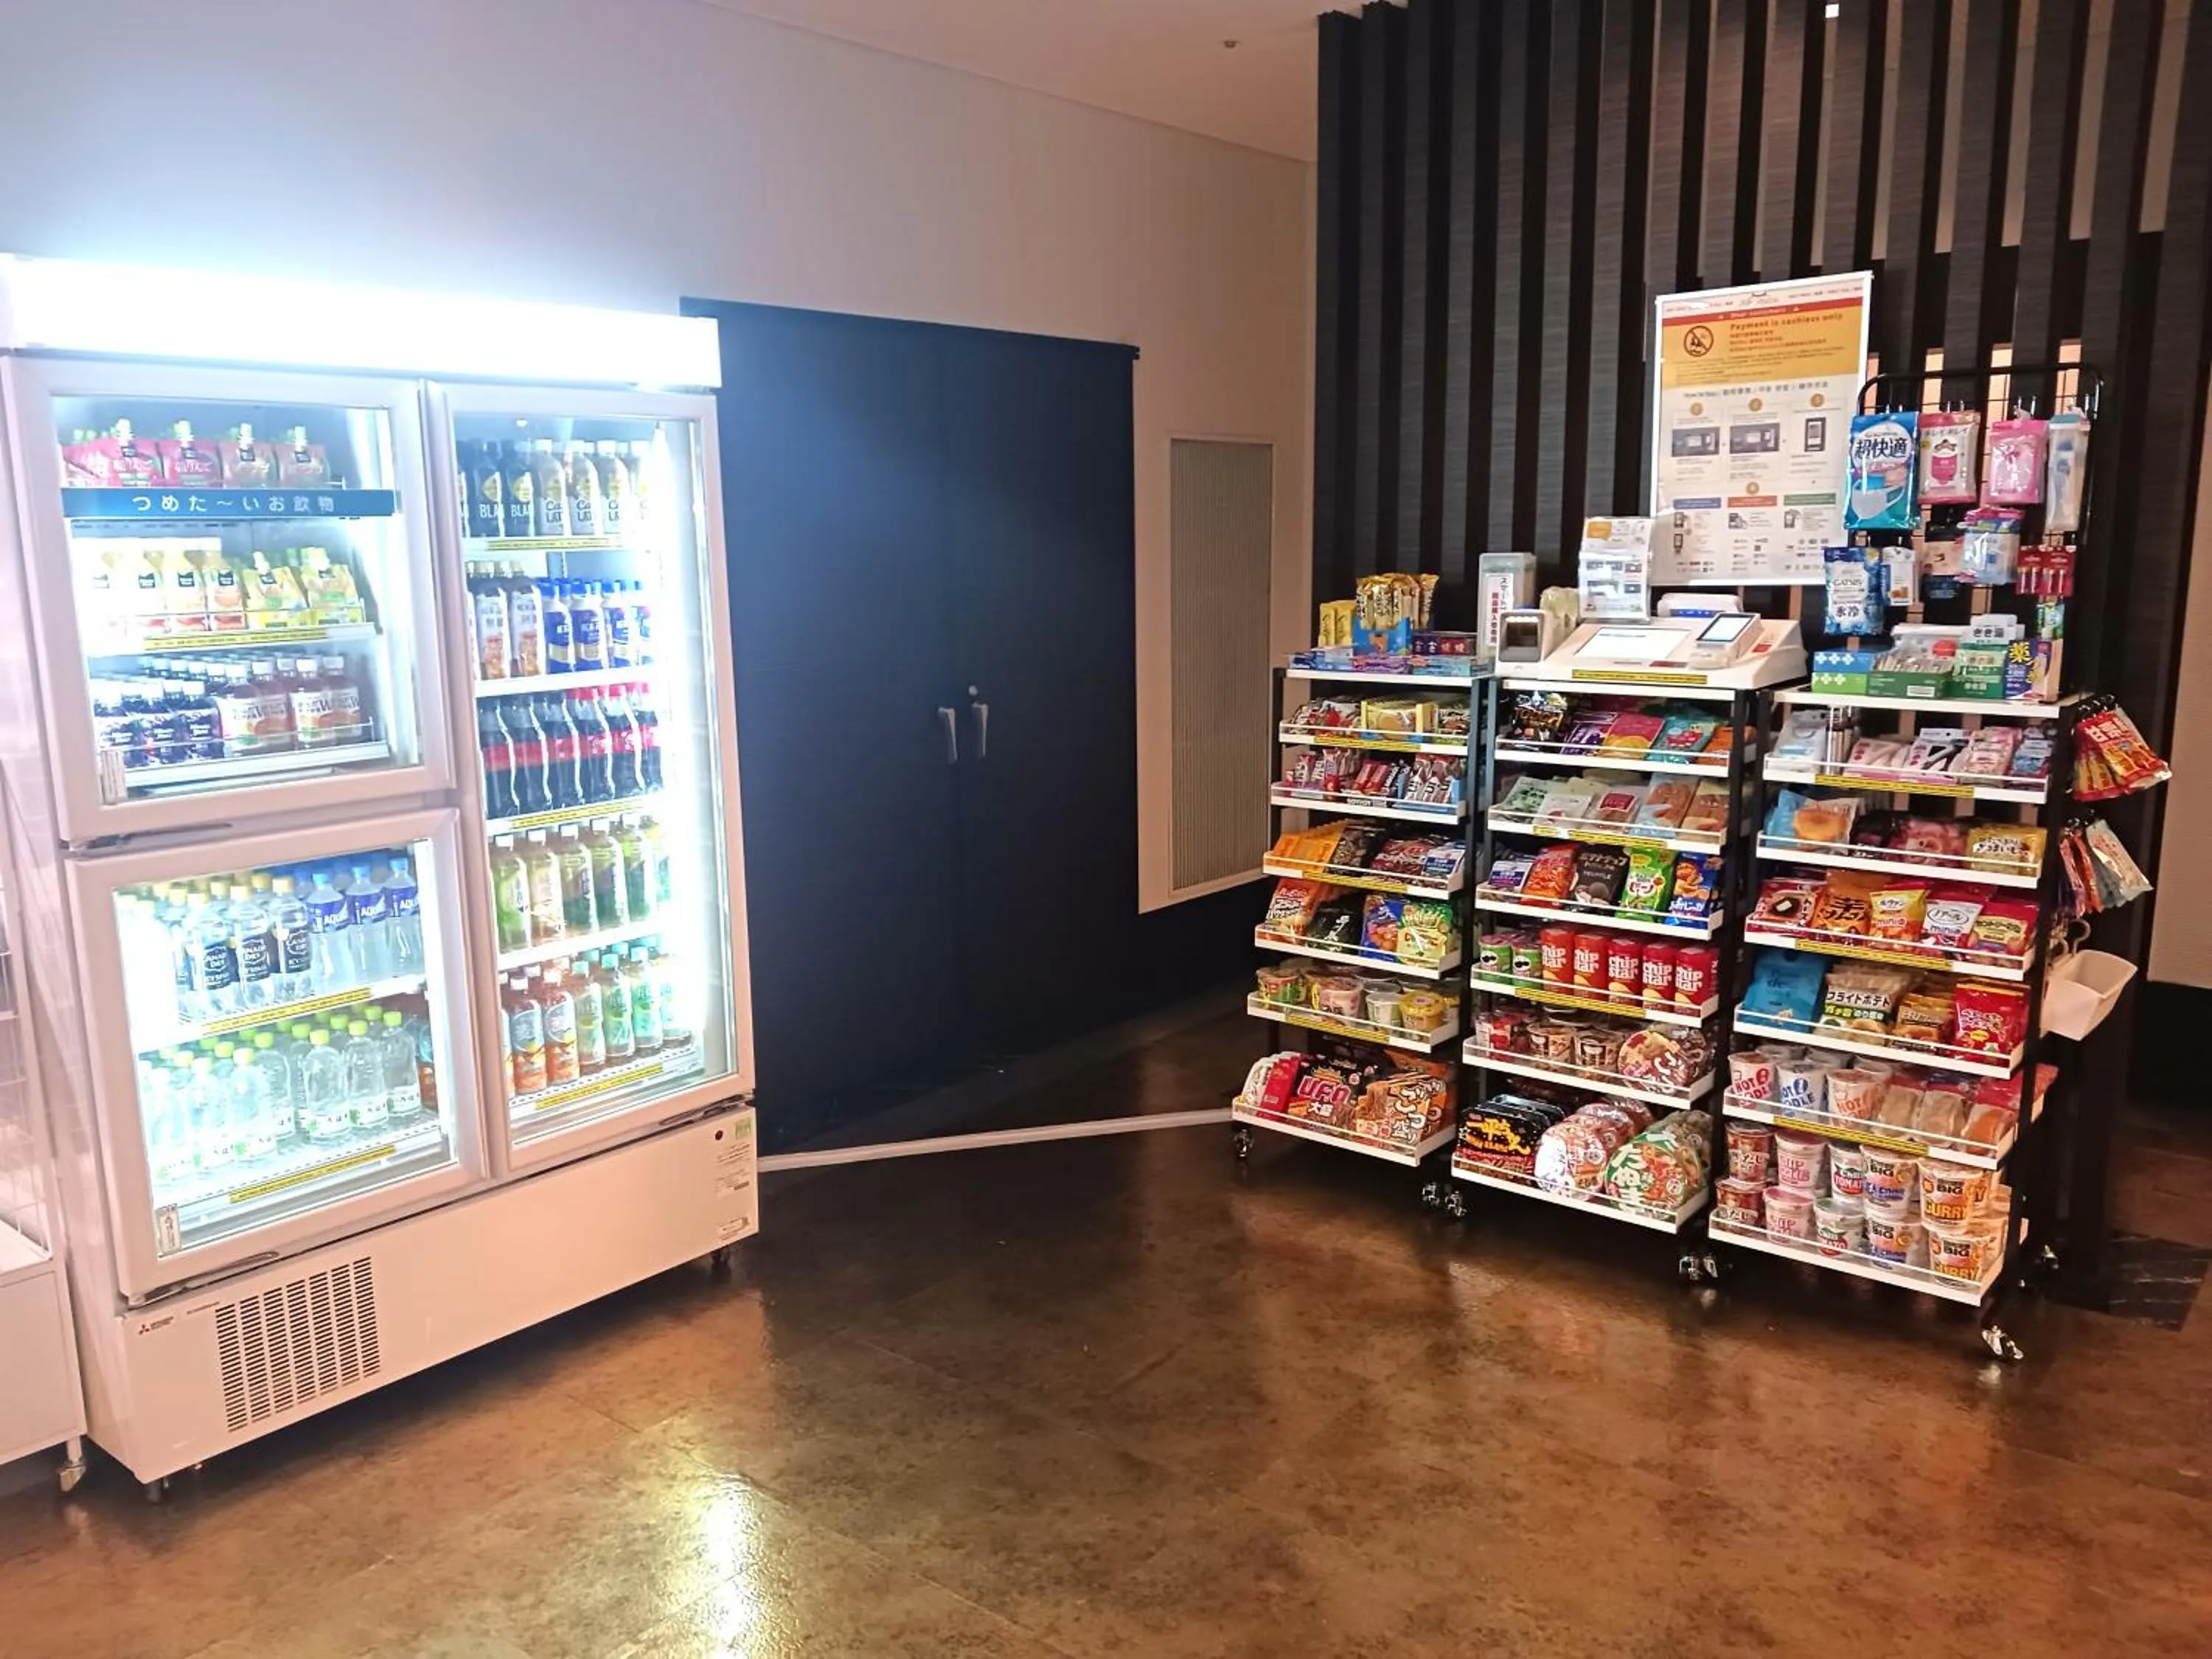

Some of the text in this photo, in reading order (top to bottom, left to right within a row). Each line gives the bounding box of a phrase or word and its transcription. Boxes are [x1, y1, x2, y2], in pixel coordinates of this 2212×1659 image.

[1730, 320, 1770, 331] Payment
[1781, 313, 1820, 325] cashless
[1822, 313, 1843, 322] only
[1854, 437, 1907, 459] 超快適
[1608, 956, 1638, 970] chip
[1642, 961, 1672, 976] chip
[1609, 967, 1638, 979] star
[1642, 973, 1672, 986] star
[1735, 1078, 1756, 1093] HOT
[1937, 1183, 1964, 1194] BIG
[1871, 1228, 1894, 1239] BIG
[1944, 1247, 1971, 1257] BIG
